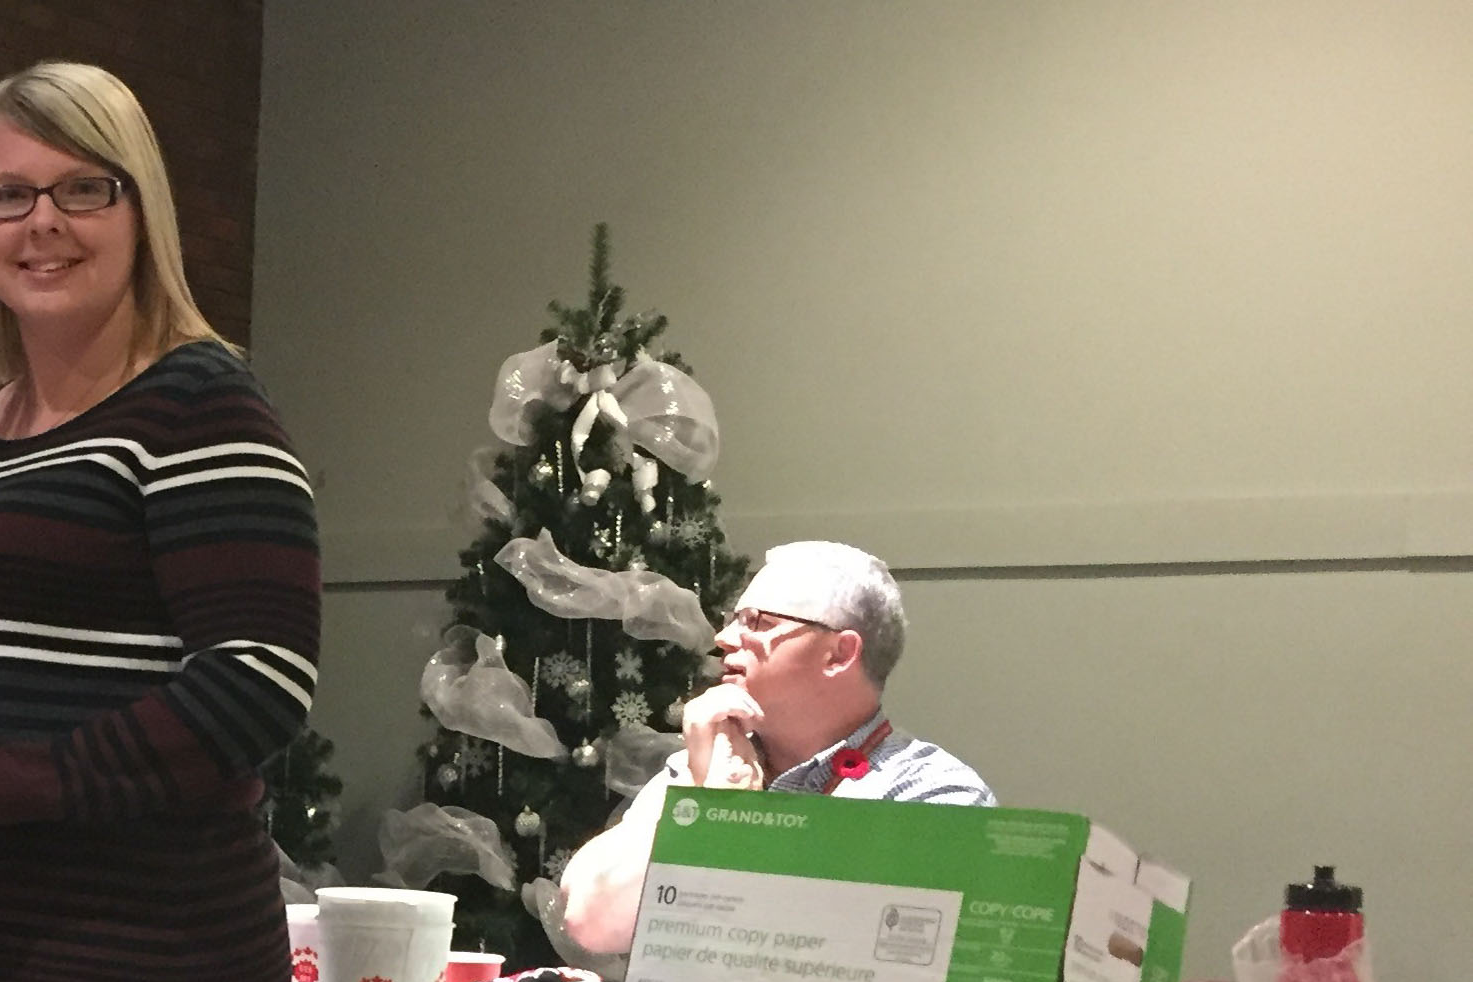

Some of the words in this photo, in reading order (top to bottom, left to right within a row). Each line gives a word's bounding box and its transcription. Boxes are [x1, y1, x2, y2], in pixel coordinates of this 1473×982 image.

[706, 807, 808, 828] GRAND&TOY
[657, 885, 677, 905] 10
[648, 918, 723, 937] premium
[728, 927, 769, 947] copy
[774, 932, 826, 951] paper
[643, 943, 694, 961] papier
[696, 944, 717, 964] de
